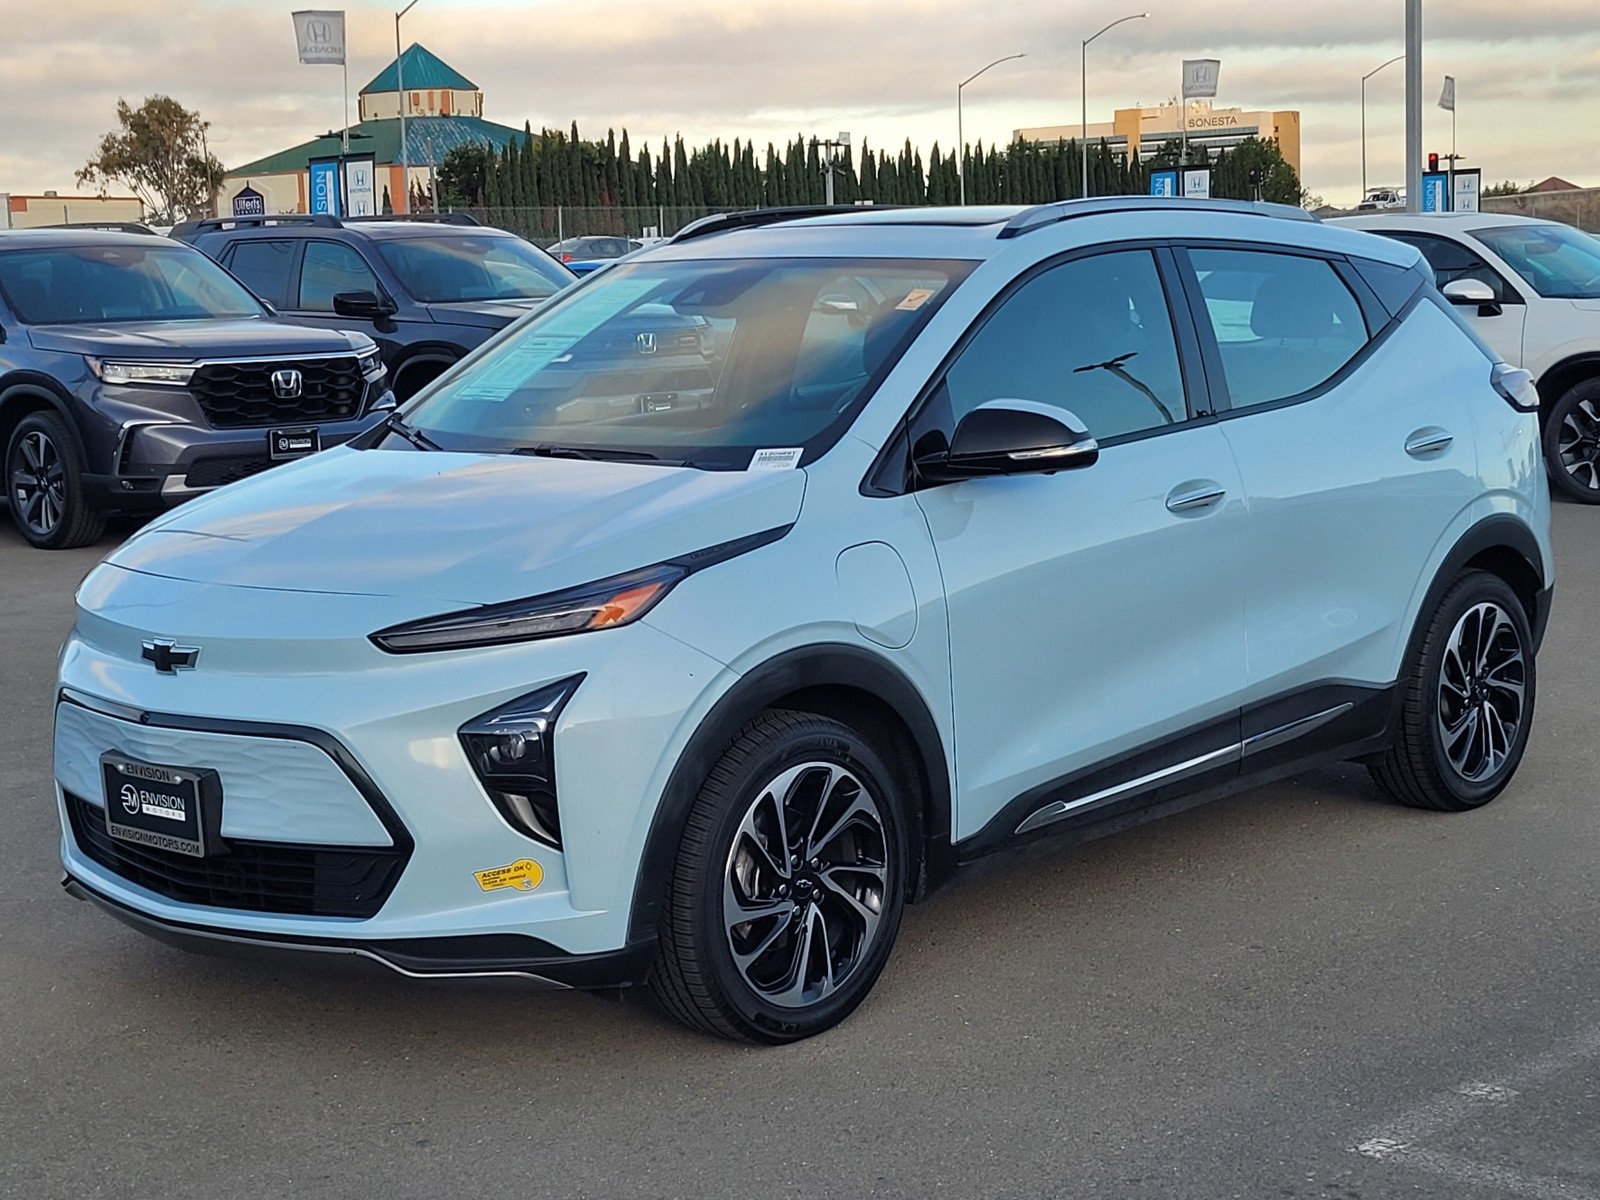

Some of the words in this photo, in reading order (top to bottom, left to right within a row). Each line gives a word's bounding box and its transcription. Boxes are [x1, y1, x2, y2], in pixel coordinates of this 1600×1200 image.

[1188, 116, 1237, 128] SONESTA
[235, 198, 261, 211] Ulferts
[126, 763, 171, 782] ENVISION
[140, 790, 186, 811] ENVISION
[111, 825, 200, 854] ENVISIONMOTORS.COM
